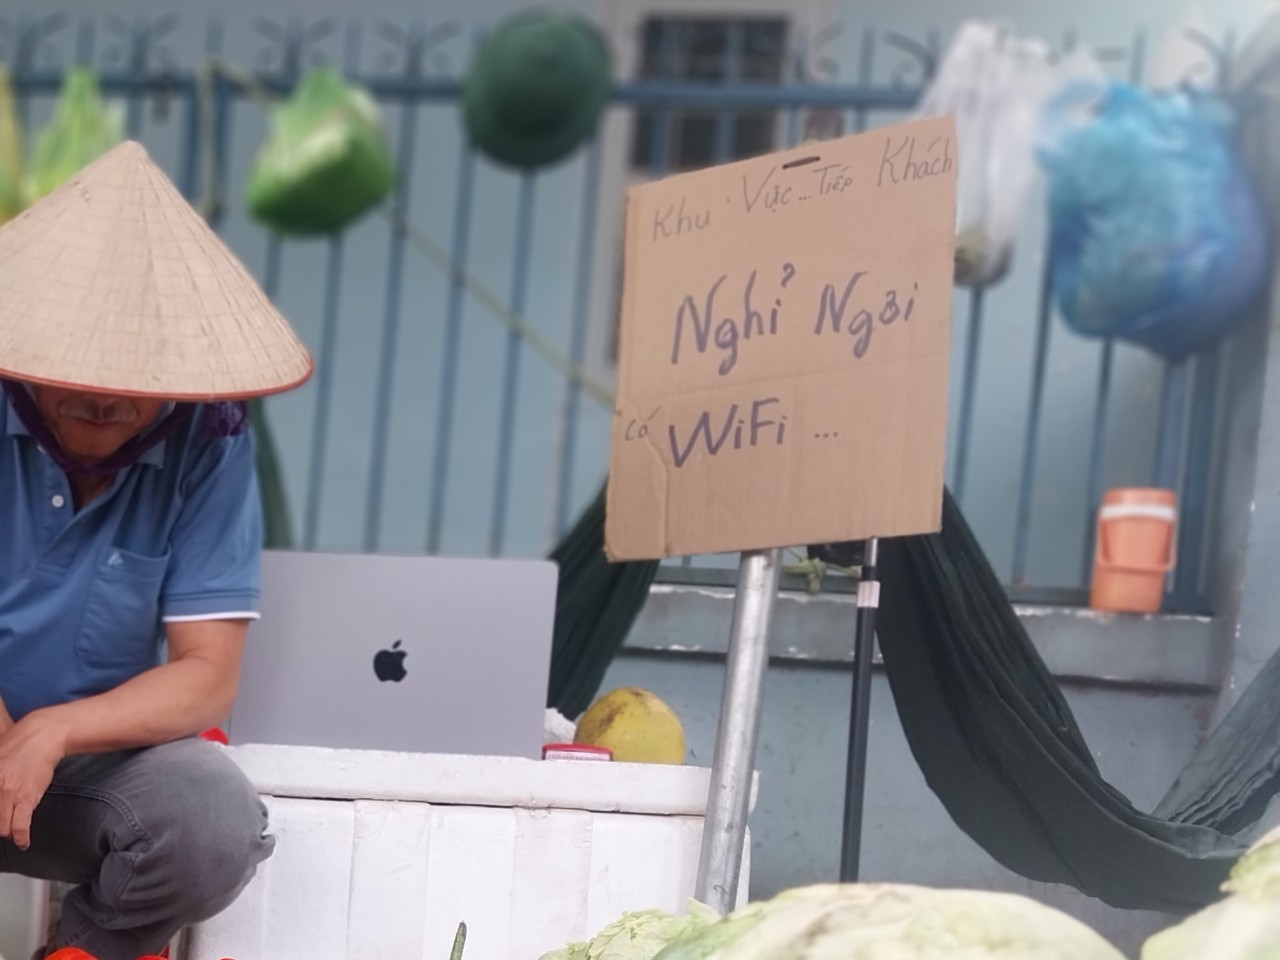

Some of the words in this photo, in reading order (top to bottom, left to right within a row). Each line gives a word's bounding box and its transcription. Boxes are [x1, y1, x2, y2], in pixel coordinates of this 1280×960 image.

[652, 197, 711, 242] Khu
[878, 136, 953, 186] Khách
[671, 262, 796, 376] Nghỉ
[668, 397, 787, 468] WiFi
